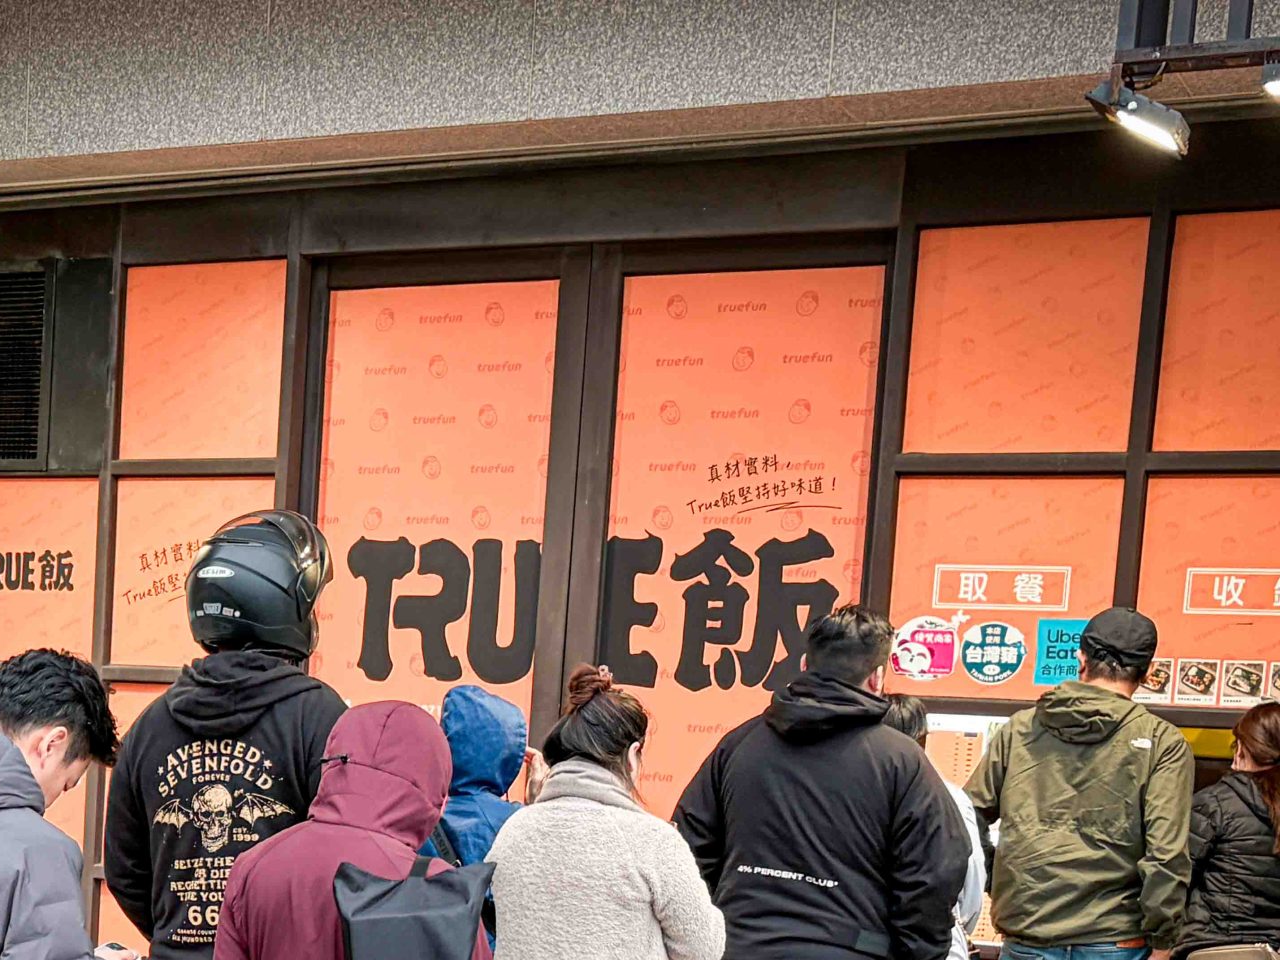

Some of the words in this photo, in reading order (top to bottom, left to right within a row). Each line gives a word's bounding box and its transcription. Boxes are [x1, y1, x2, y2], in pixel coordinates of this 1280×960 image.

[122, 572, 188, 605] True飯堅
[958, 573, 1044, 602] 取餐
[1213, 576, 1280, 607] 收
[1047, 629, 1082, 644] Ube
[1046, 645, 1078, 660] Eat
[1041, 663, 1078, 677] 合作商
[166, 739, 261, 771] AVENGED
[158, 756, 273, 798] SEVENFOLD
[192, 773, 231, 785] FOREVER
[205, 856, 235, 869] THE
[754, 866, 804, 880] PERCENT
